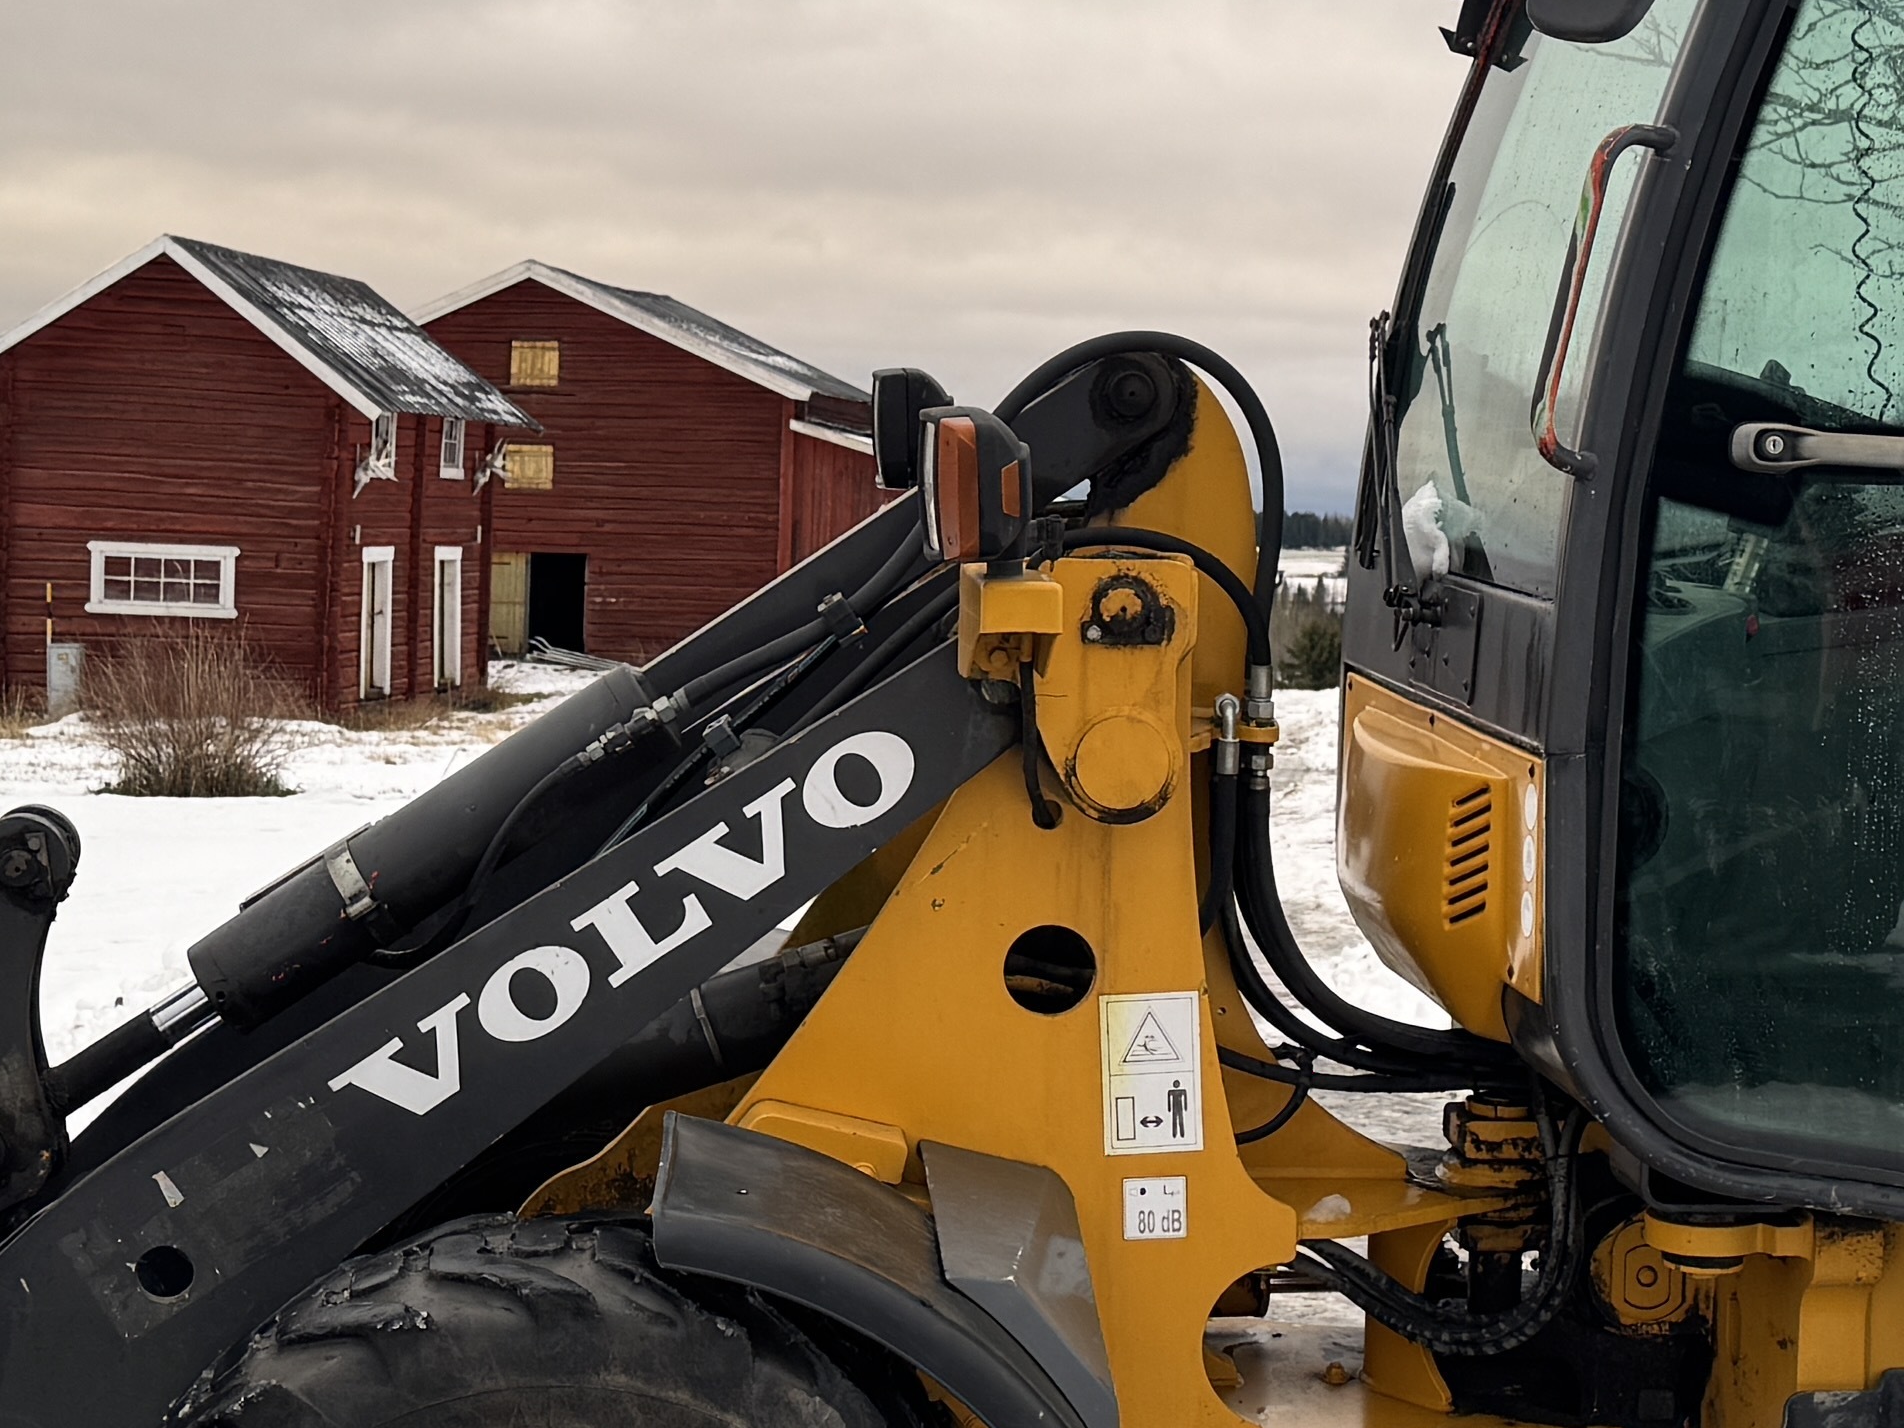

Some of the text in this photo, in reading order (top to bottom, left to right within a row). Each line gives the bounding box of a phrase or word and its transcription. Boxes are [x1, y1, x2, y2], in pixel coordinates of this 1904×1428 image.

[327, 730, 916, 1116] VOLVO
[1138, 1209, 1182, 1234] 80 dB
